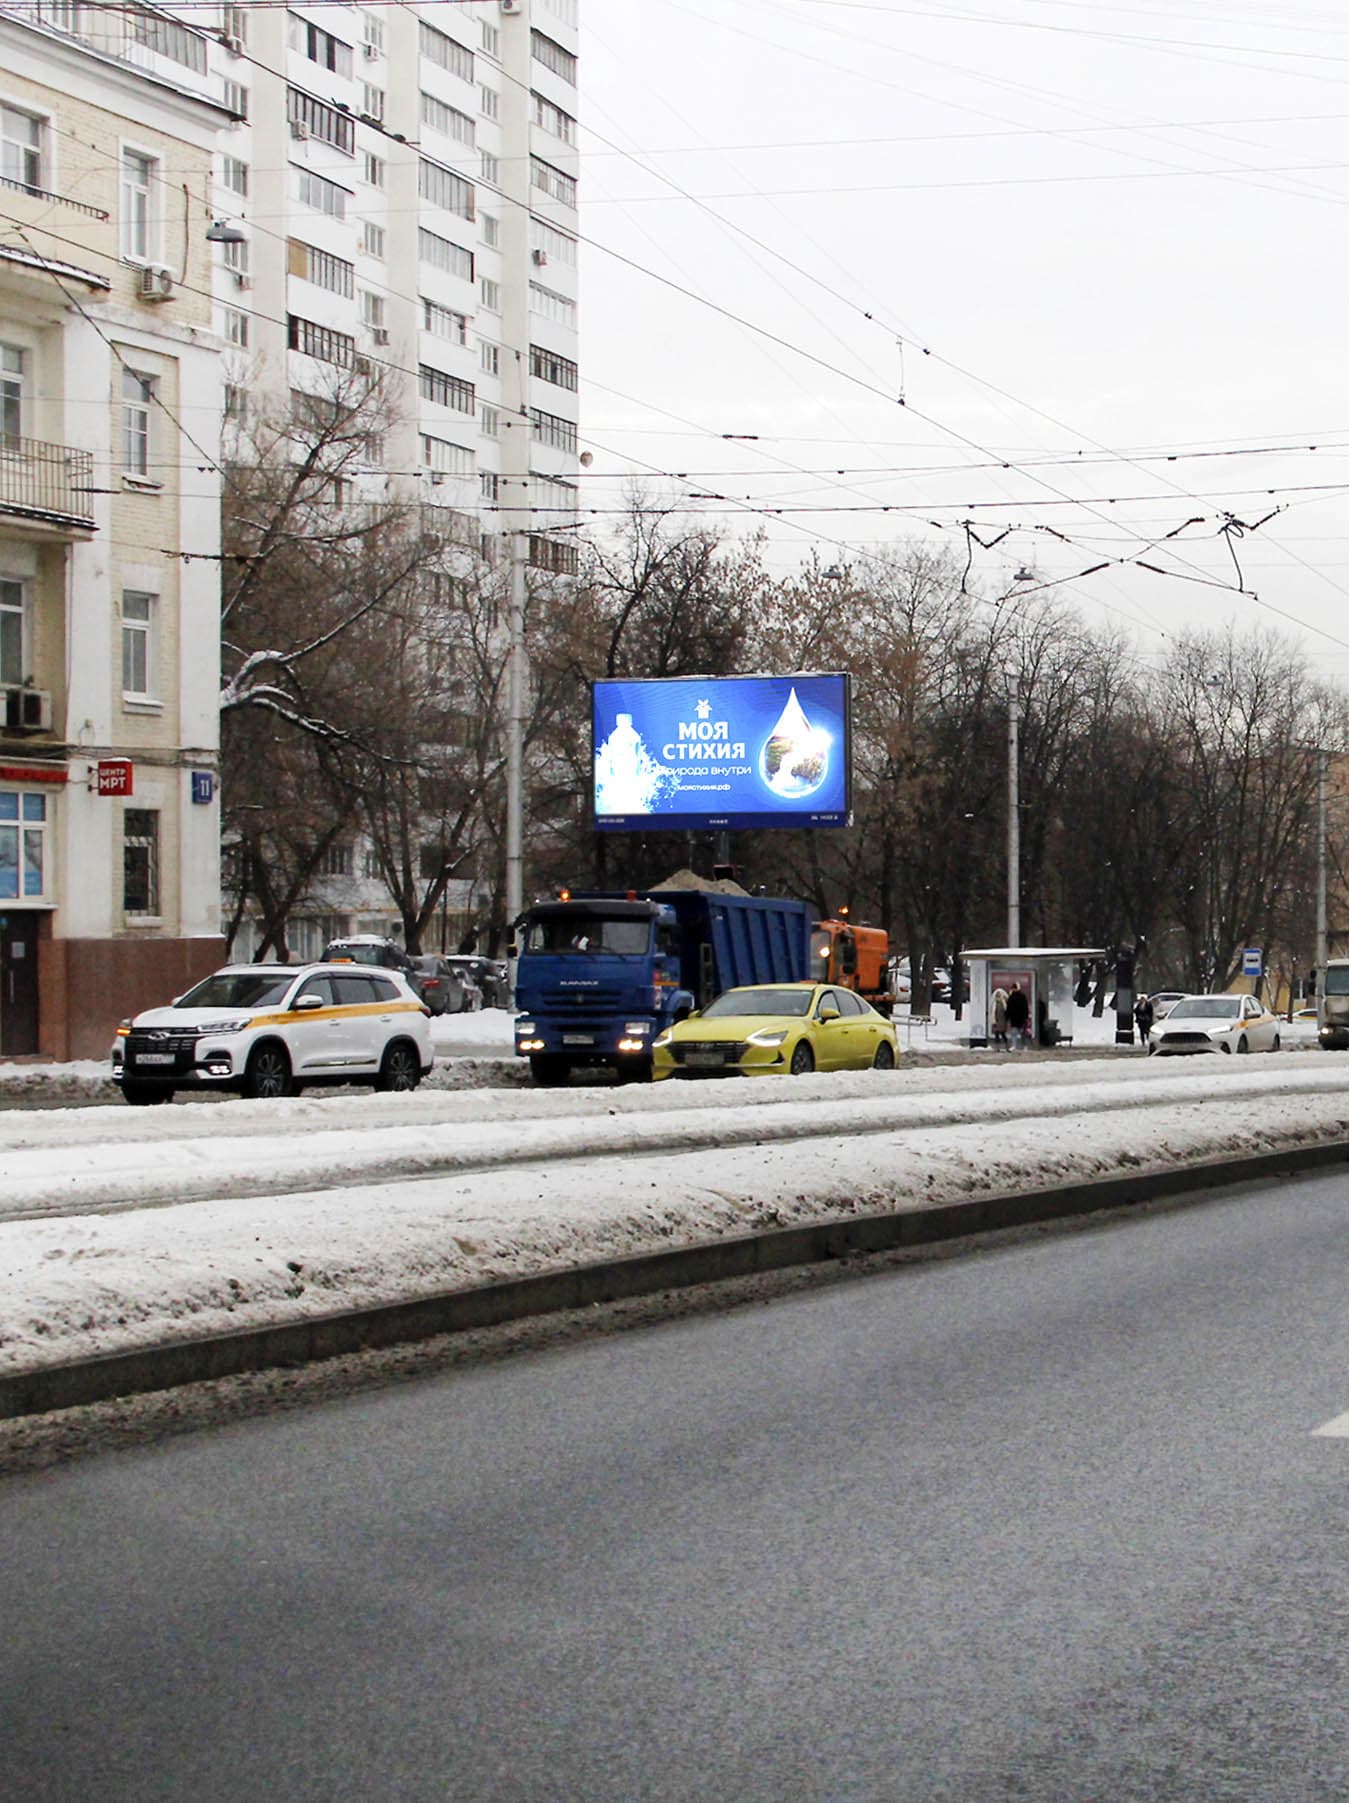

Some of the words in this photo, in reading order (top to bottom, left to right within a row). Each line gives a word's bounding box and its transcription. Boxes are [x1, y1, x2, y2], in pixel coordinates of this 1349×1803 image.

[678, 721, 728, 741] МОЯ
[662, 742, 746, 760] СТИХИЯ
[100, 768, 126, 776] ЦЕНТР
[710, 765, 752, 777] внутри
[100, 777, 126, 789] МРТ
